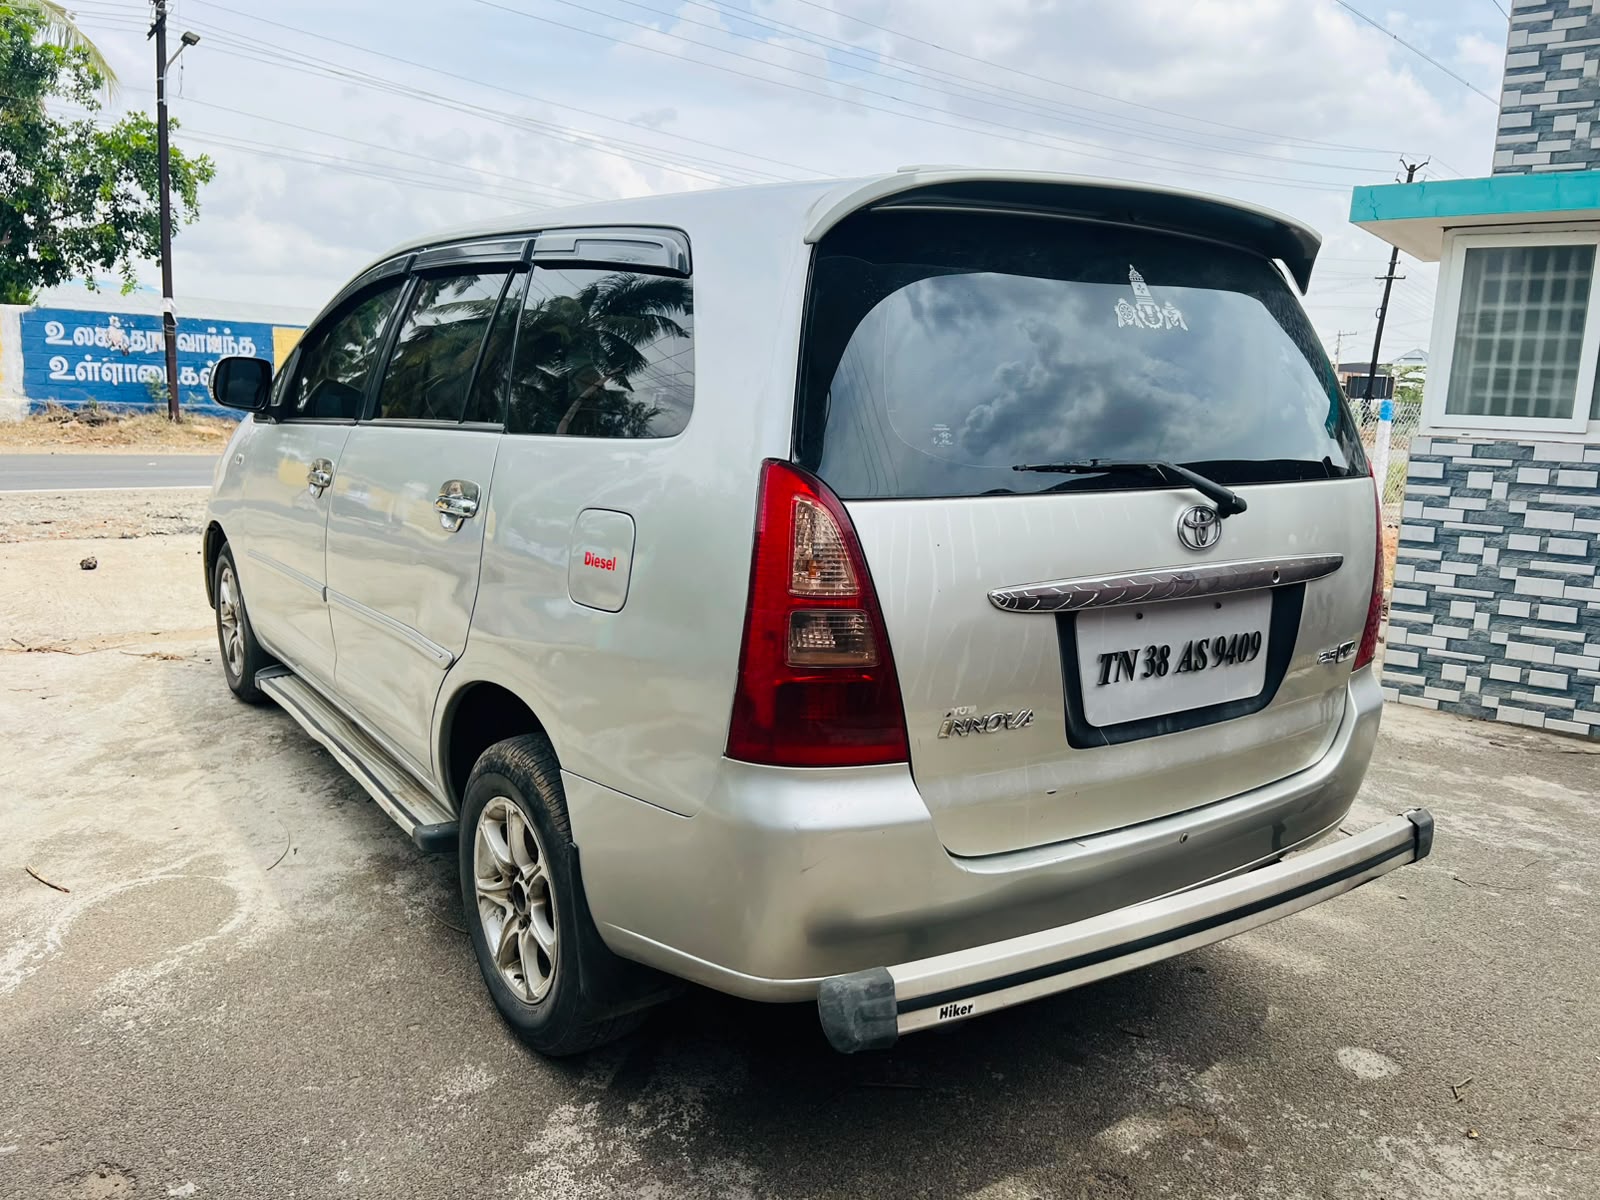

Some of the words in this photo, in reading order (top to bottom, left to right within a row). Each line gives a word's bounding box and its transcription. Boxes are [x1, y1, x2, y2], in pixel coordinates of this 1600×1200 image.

[584, 551, 617, 571] Diesel
[1097, 649, 1140, 686] TN
[1143, 645, 1171, 678] 38
[1174, 638, 1210, 674] AS
[1211, 631, 1262, 668] 9409
[939, 1003, 973, 1020] Hiker
